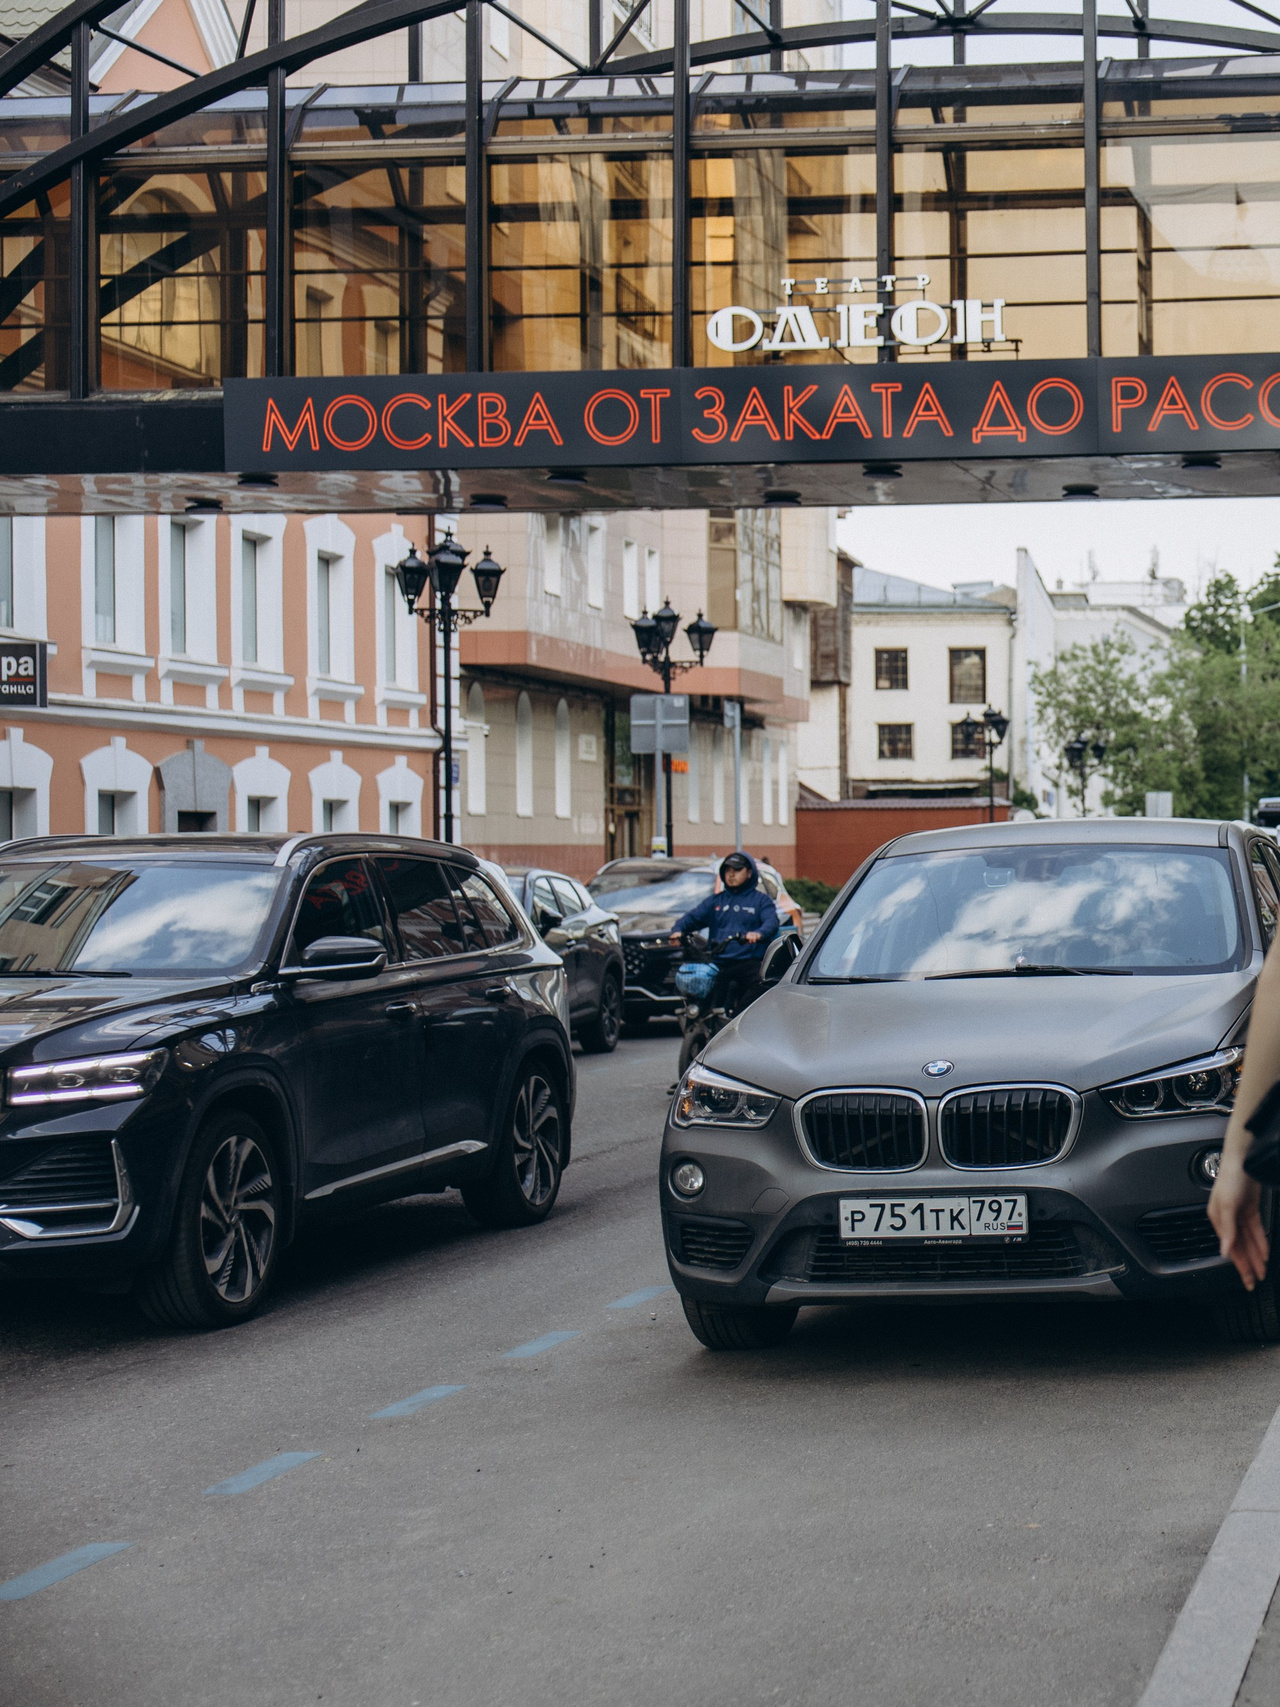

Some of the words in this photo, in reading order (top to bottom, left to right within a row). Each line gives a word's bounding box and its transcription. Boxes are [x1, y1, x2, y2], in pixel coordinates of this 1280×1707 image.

[780, 274, 931, 295] ТЕАТР
[706, 299, 1007, 352] ОДЕОН
[262, 391, 564, 452] МОСКВА
[583, 388, 671, 446] ОТ
[691, 381, 954, 444] ЗАКАТА
[971, 377, 1084, 444] ДО
[1, 655, 35, 681] ра
[0, 684, 34, 695] анца
[972, 1199, 1018, 1222] 797
[984, 1222, 1006, 1231] RUS
